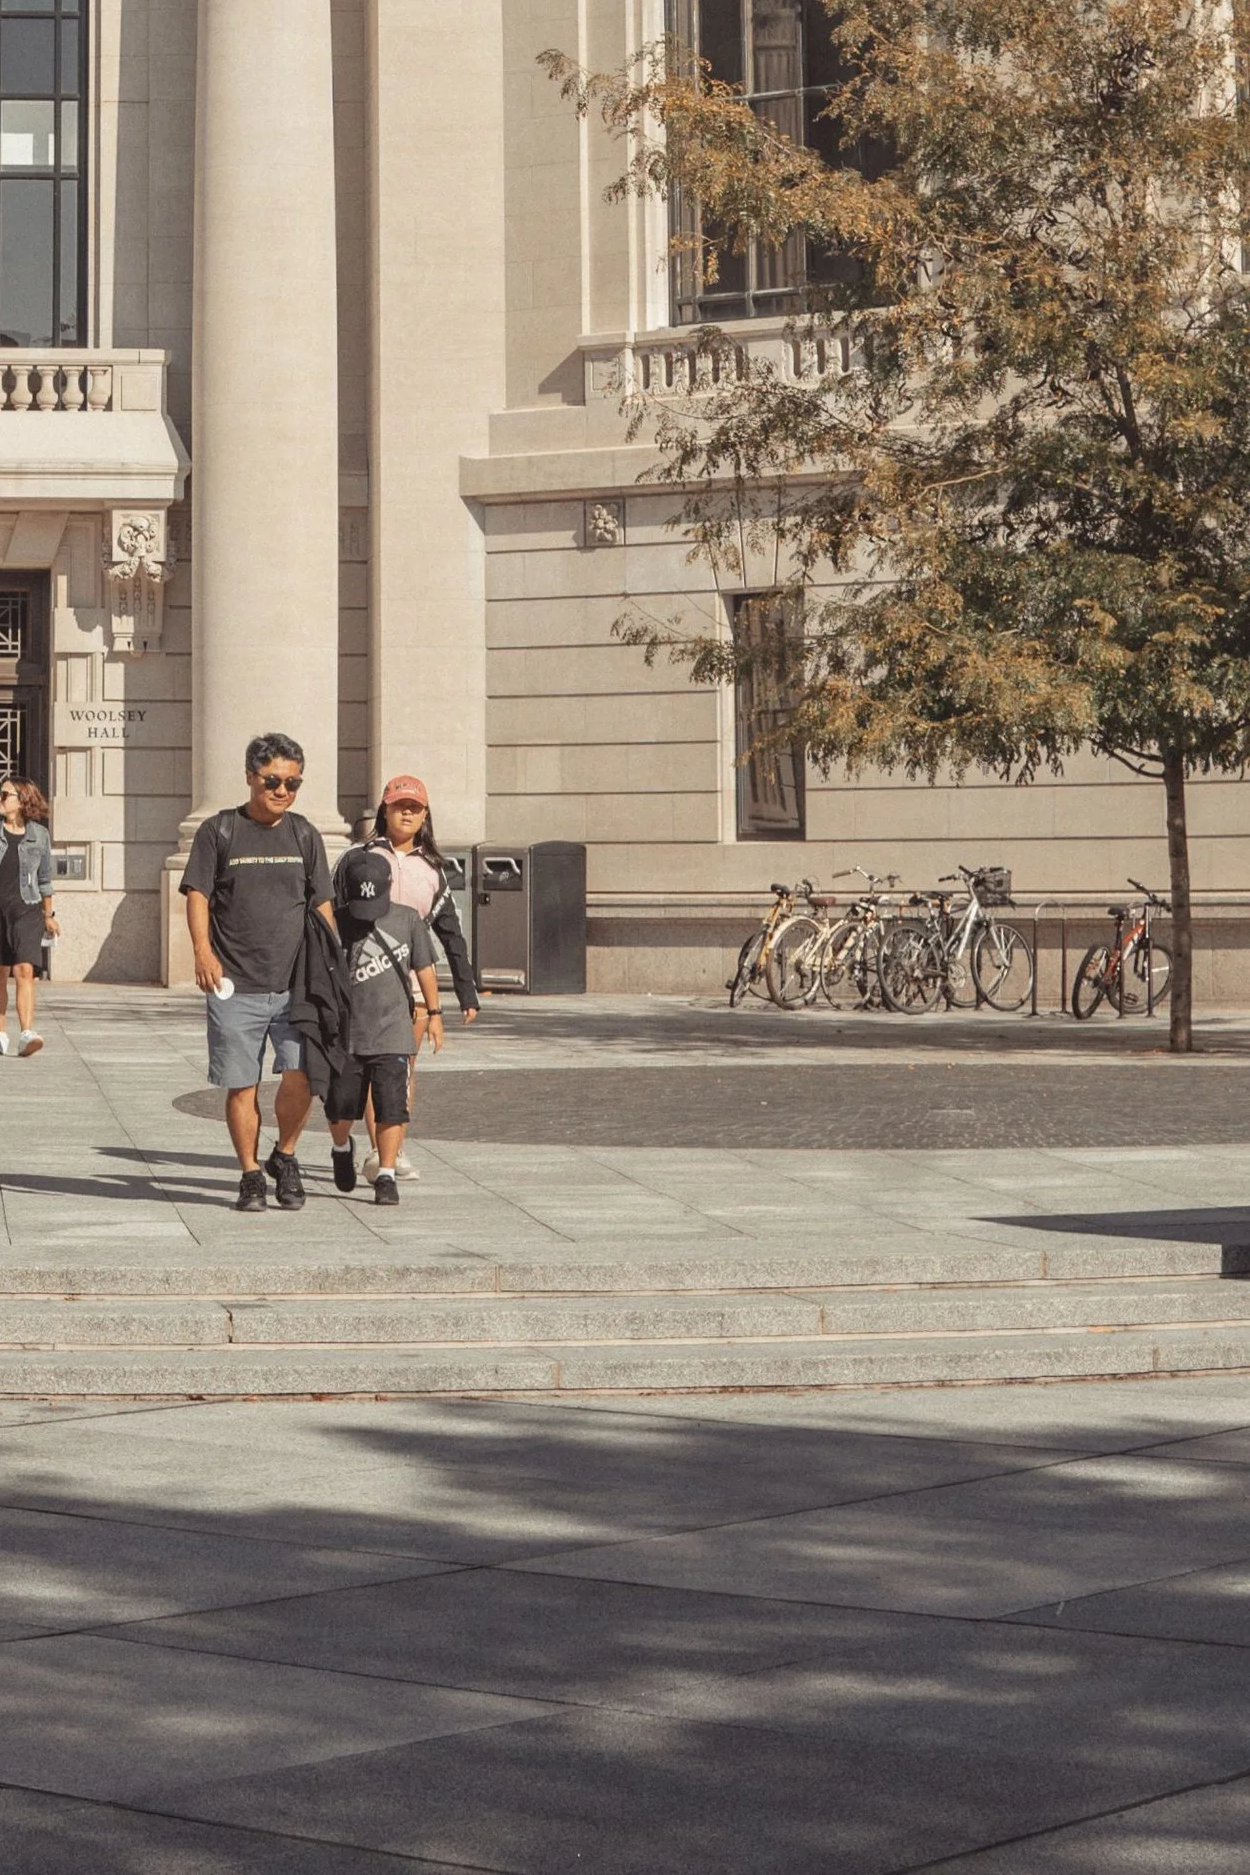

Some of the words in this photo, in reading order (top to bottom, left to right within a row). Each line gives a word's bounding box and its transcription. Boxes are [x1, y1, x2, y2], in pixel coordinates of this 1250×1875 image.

[70, 710, 146, 722] WOOLSEY
[87, 727, 130, 739] HALL
[360, 881, 375, 898] NY
